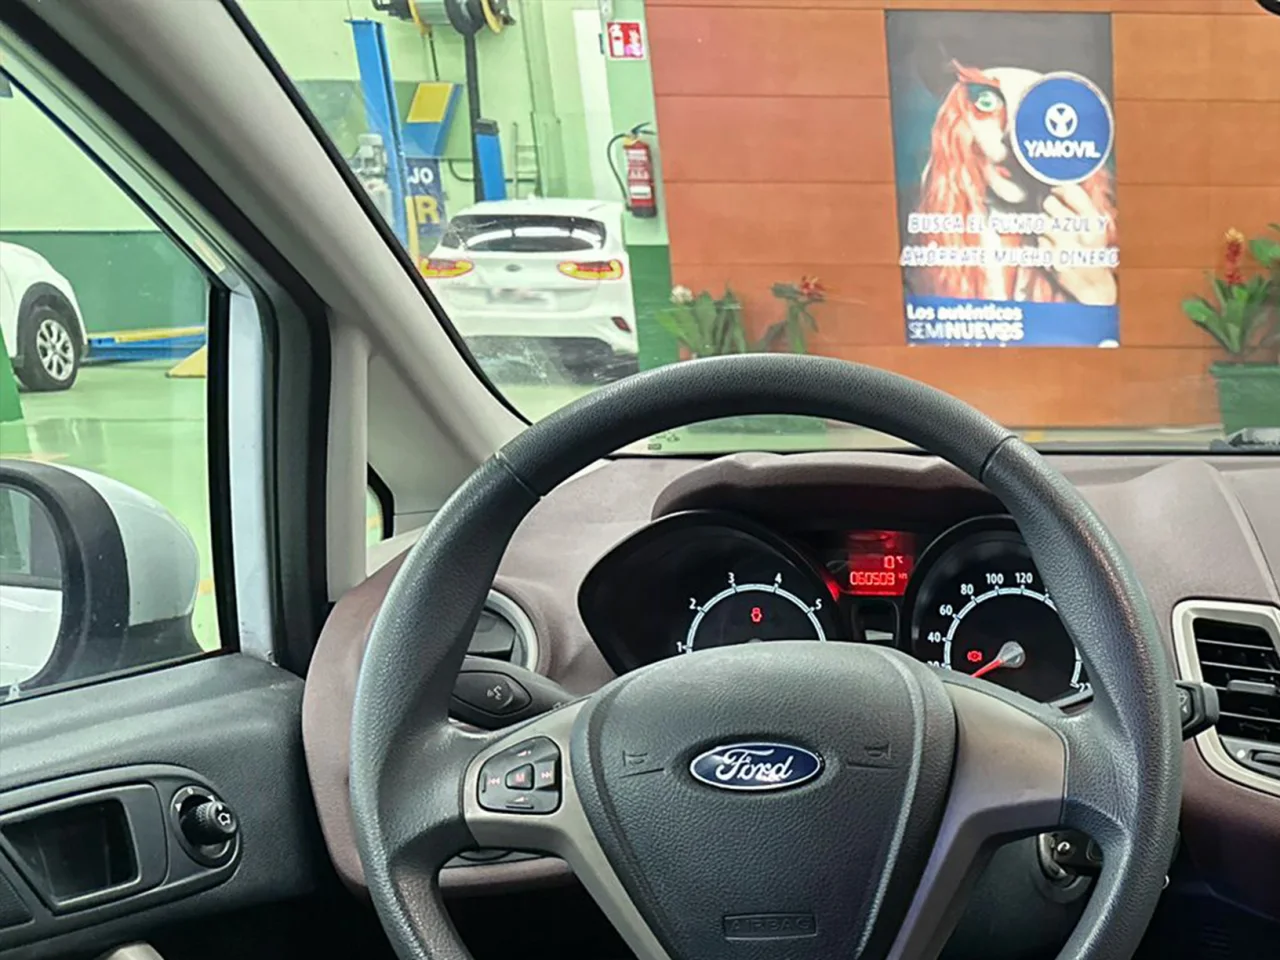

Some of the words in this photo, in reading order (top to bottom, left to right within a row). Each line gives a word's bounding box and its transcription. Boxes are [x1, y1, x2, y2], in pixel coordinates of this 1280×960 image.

[1023, 138, 1101, 159] YAMOVIL
[908, 213, 964, 233] BUSCA
[1050, 214, 1092, 233] AZUL
[1057, 248, 1120, 266] DINERO
[907, 304, 935, 320] Los
[728, 572, 735, 583] 3
[775, 573, 782, 583] 4
[985, 573, 1004, 584] 100
[1015, 573, 1033, 583] 120
[960, 584, 974, 595] 80
[689, 598, 697, 609] 2
[815, 598, 823, 610] 5
[939, 605, 953, 615] 60
[927, 632, 941, 643] 40
[712, 748, 794, 781] Ford
